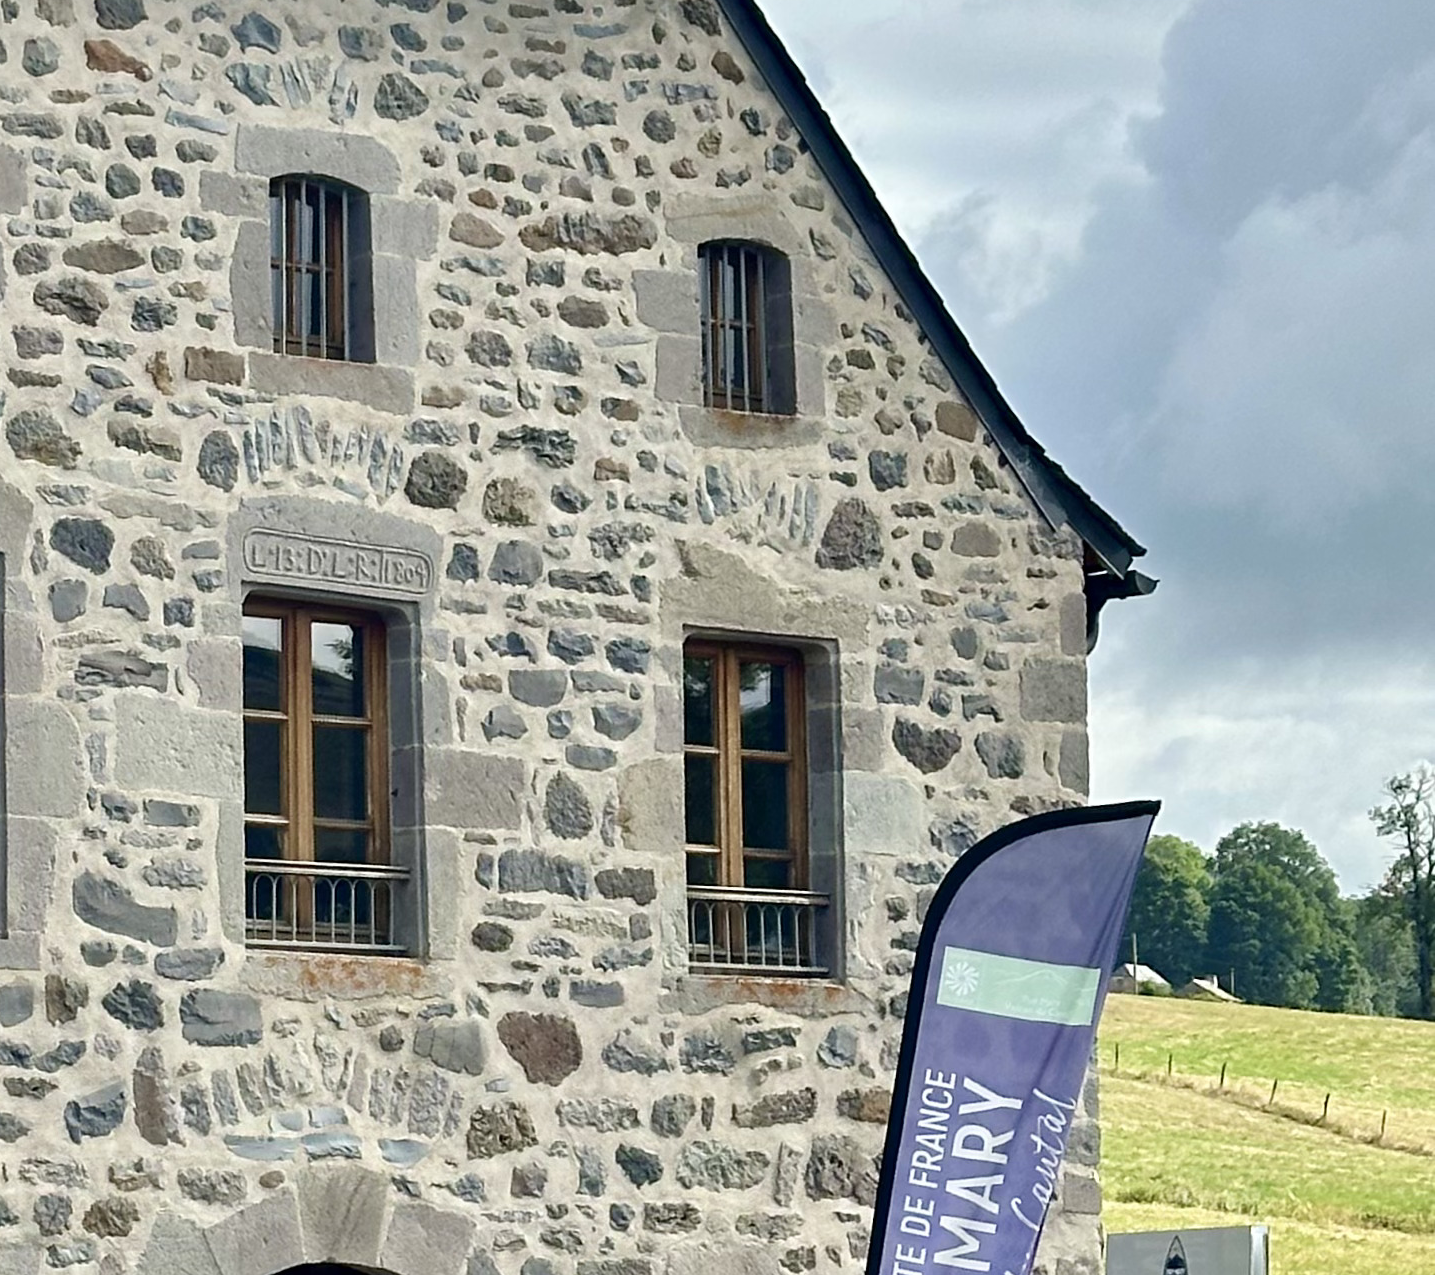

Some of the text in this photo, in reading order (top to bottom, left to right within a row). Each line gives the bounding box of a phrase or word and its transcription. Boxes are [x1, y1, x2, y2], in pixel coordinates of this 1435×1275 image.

[908, 1068, 957, 1189] FRANCE
[933, 1076, 1024, 1272] MARY
[900, 1195, 936, 1237] DE
